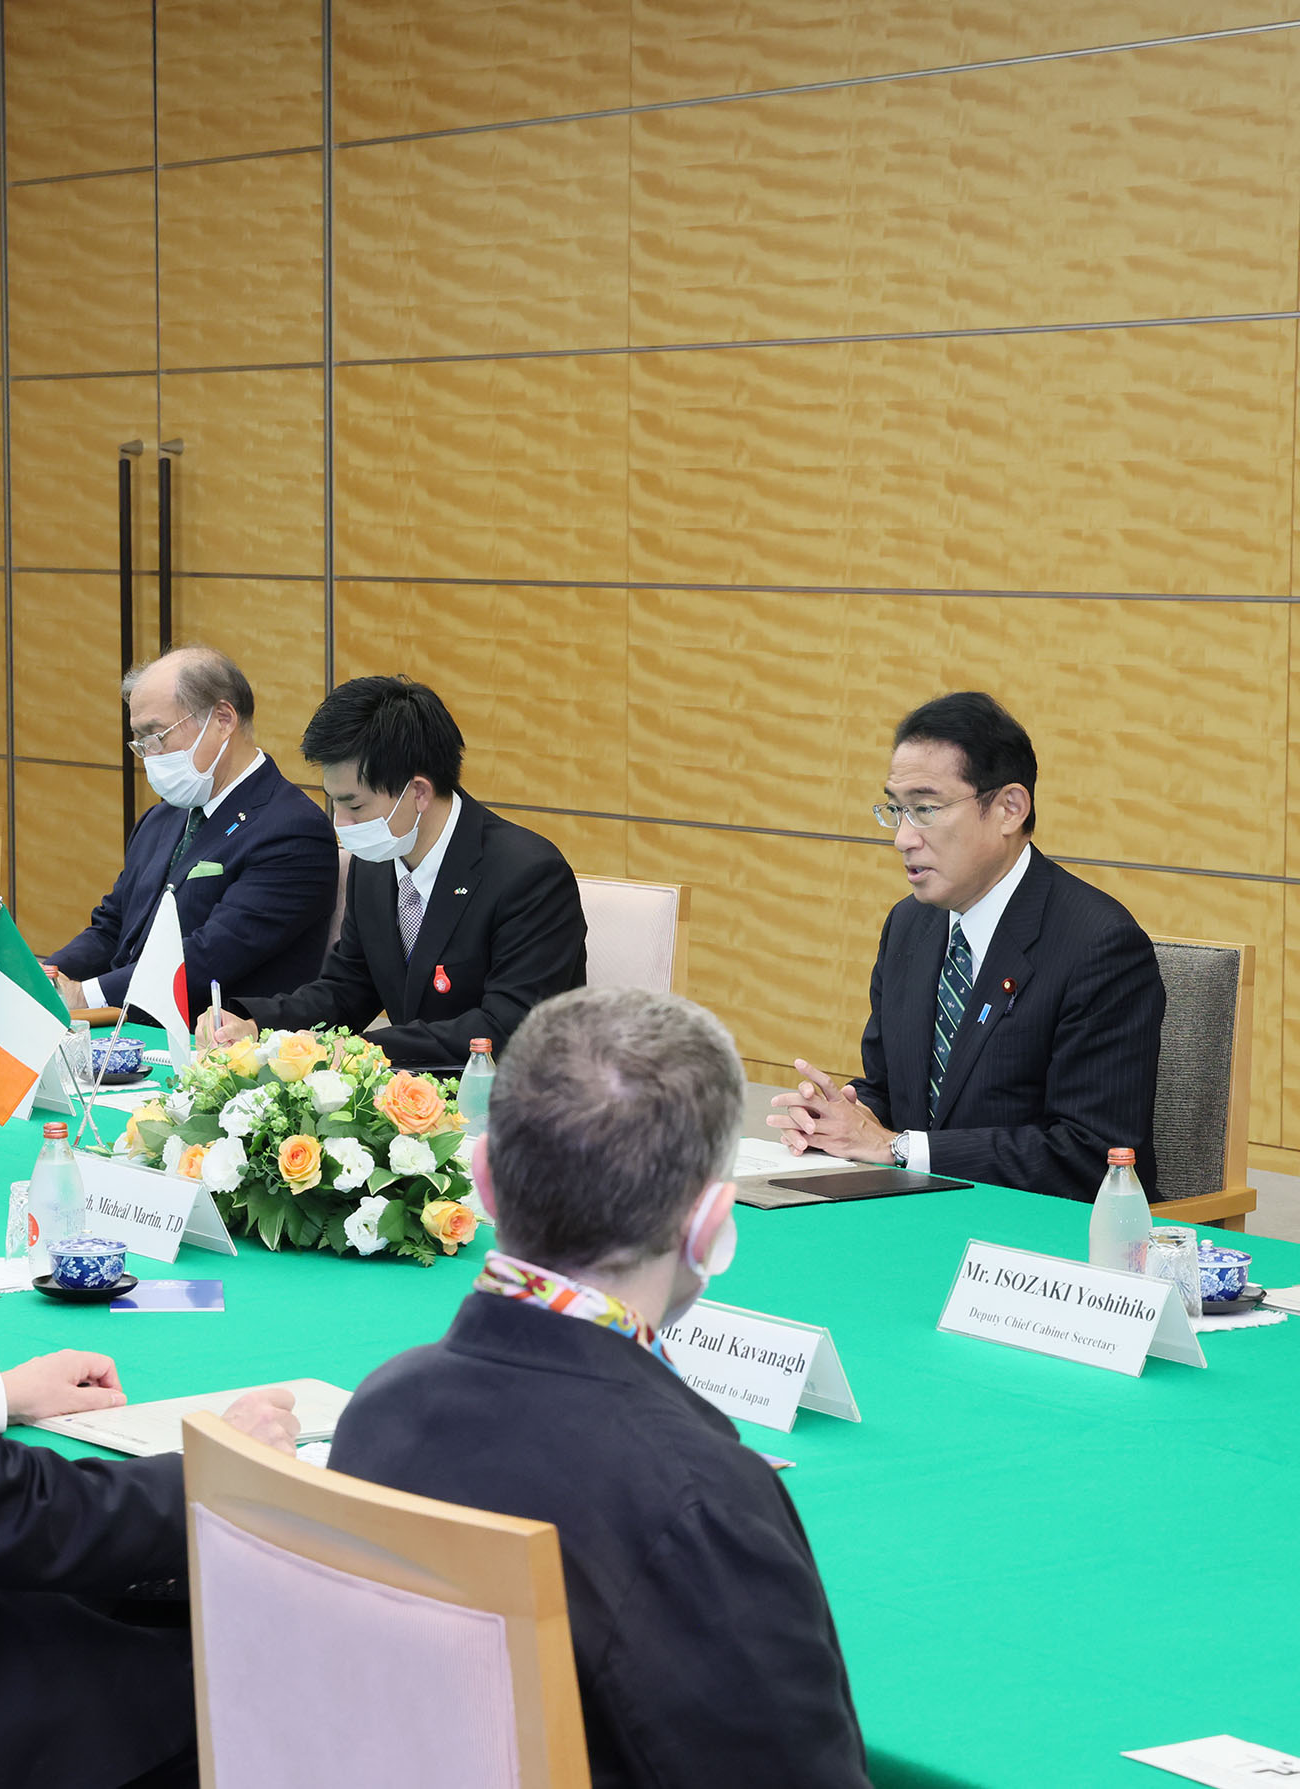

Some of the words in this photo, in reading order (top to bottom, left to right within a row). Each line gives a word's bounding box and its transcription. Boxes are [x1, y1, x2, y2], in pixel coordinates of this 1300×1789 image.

[962, 1261, 990, 1285] Mr.
[994, 1268, 1073, 1303] ISOZAKI
[1077, 1286, 1157, 1322] Yoshihiko
[689, 1326, 725, 1353] Paul
[728, 1336, 806, 1377] Kavanagh
[969, 1306, 1002, 1327] Deputy
[1005, 1315, 1031, 1332] Chief
[1033, 1321, 1069, 1341] Cabinet
[1071, 1332, 1118, 1353] Secretary
[692, 1376, 727, 1396] Ireland
[729, 1386, 738, 1398] to
[740, 1389, 770, 1408] Japan
